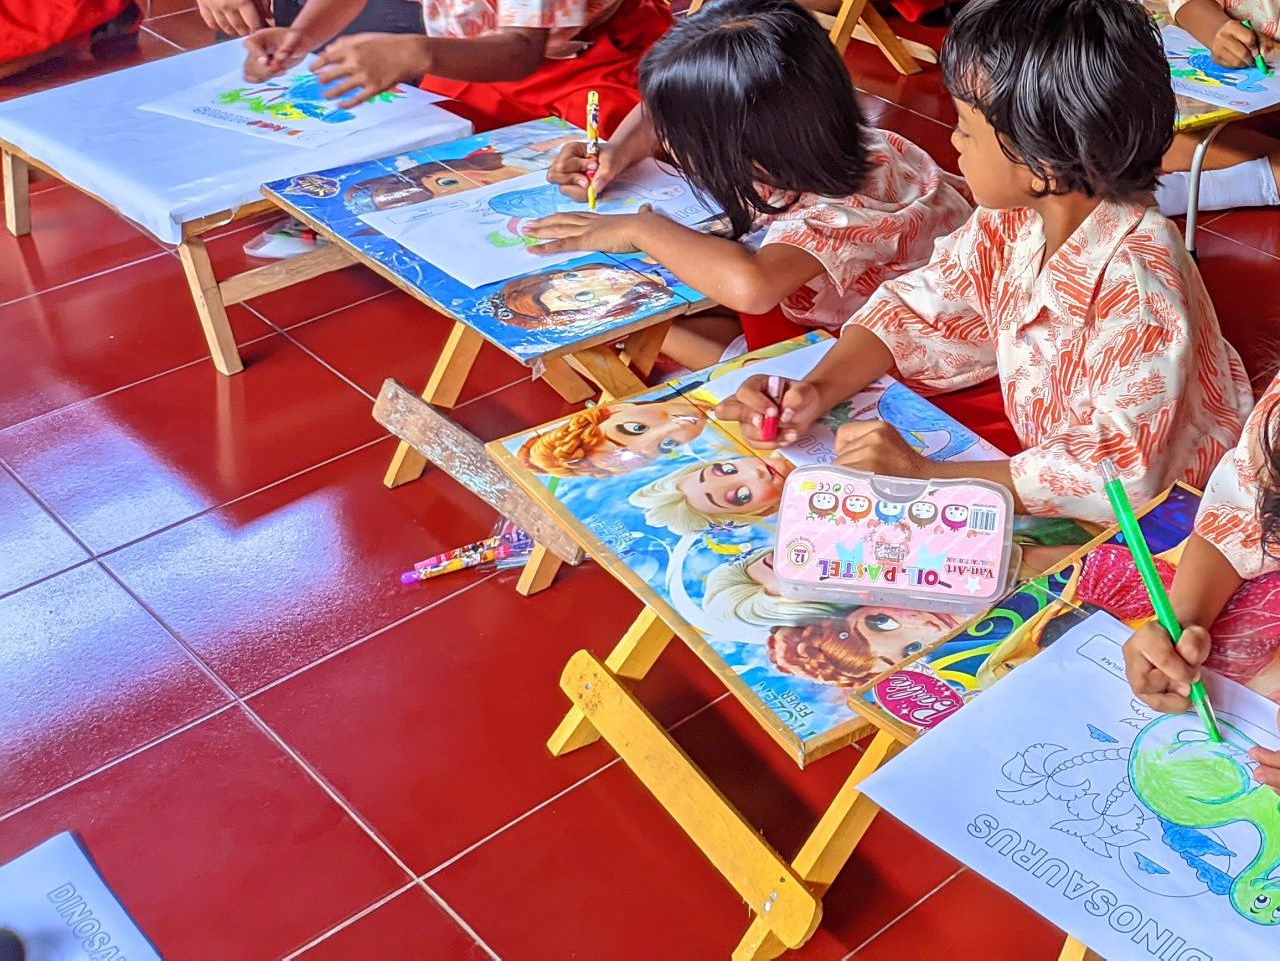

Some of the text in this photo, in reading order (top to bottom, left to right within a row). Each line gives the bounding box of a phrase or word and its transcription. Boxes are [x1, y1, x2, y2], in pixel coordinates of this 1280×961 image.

[795, 553, 805, 563] 12
[947, 565, 994, 578] Van-Art
[818, 559, 939, 587] OIL PASTEL
[781, 689, 814, 717] FEVER
[886, 674, 959, 724] Barbie
[967, 813, 1212, 961] DINOSAURUS
